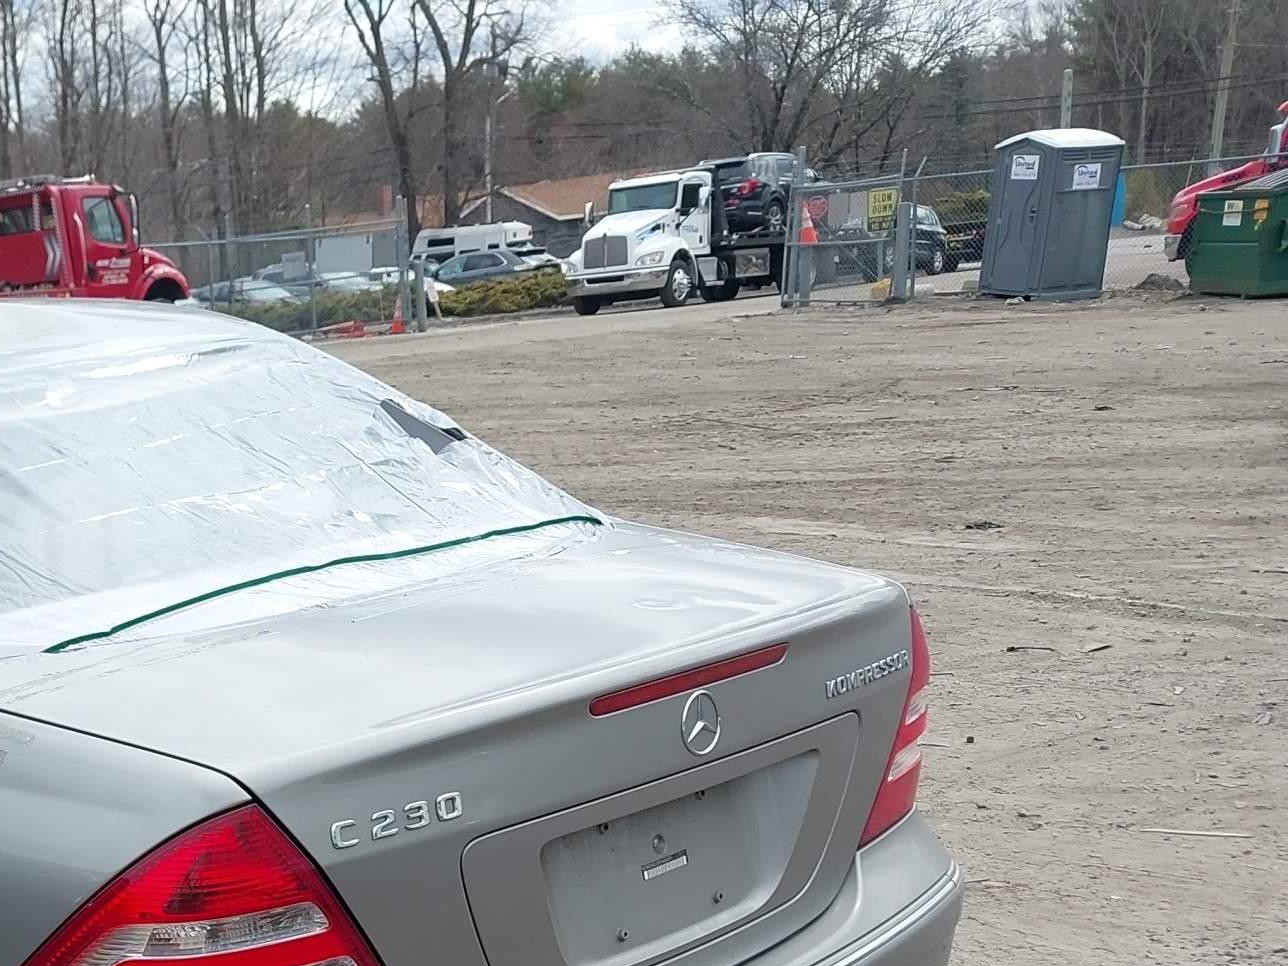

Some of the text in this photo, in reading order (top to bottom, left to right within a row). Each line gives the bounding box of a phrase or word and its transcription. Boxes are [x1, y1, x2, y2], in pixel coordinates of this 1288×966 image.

[1015, 160, 1036, 168] United
[873, 192, 892, 204] SLOW
[872, 203, 893, 215] DOWN
[825, 649, 910, 699] KOMPRESSOR
[330, 791, 463, 850] C 230
